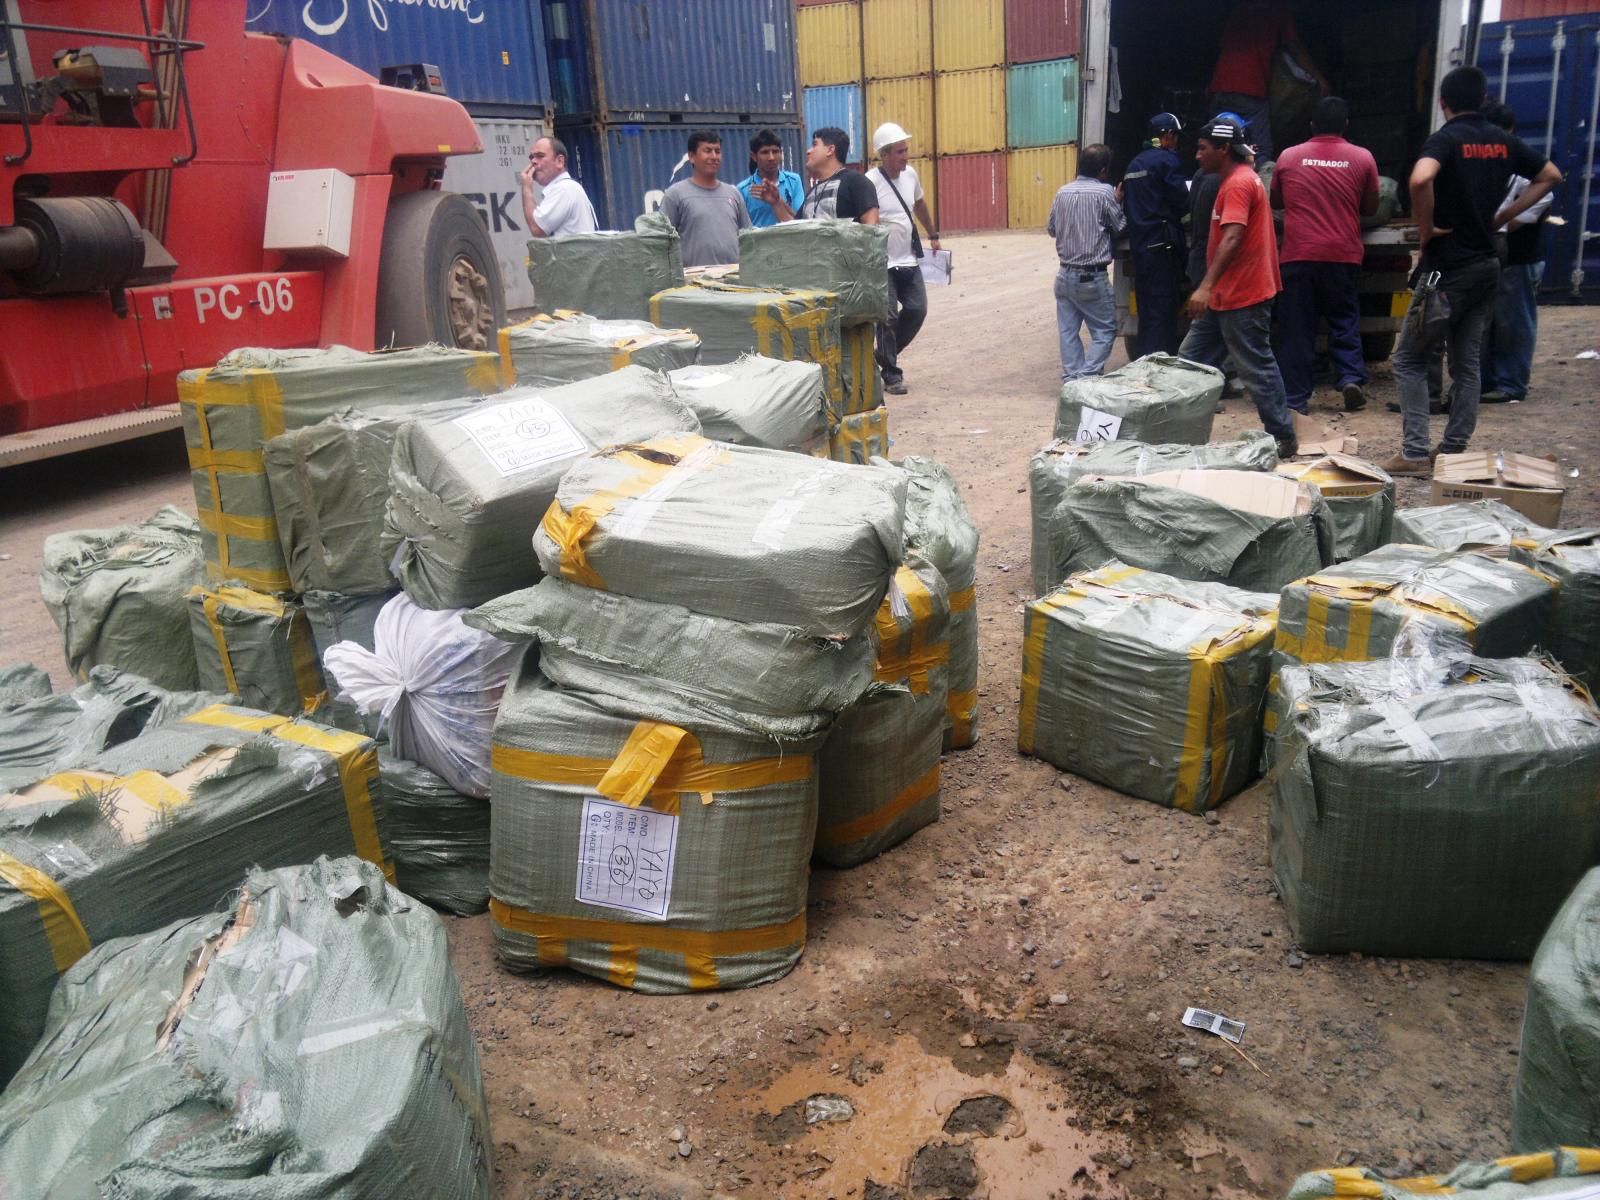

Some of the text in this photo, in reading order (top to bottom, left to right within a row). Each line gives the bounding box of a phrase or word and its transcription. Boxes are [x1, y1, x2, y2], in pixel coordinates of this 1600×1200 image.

[1302, 158, 1350, 168] ESTIBADOR
[193, 277, 293, 324] PC 06
[588, 831, 598, 854] MADE
[613, 854, 630, 878] 36
[584, 867, 594, 891] CHINA
